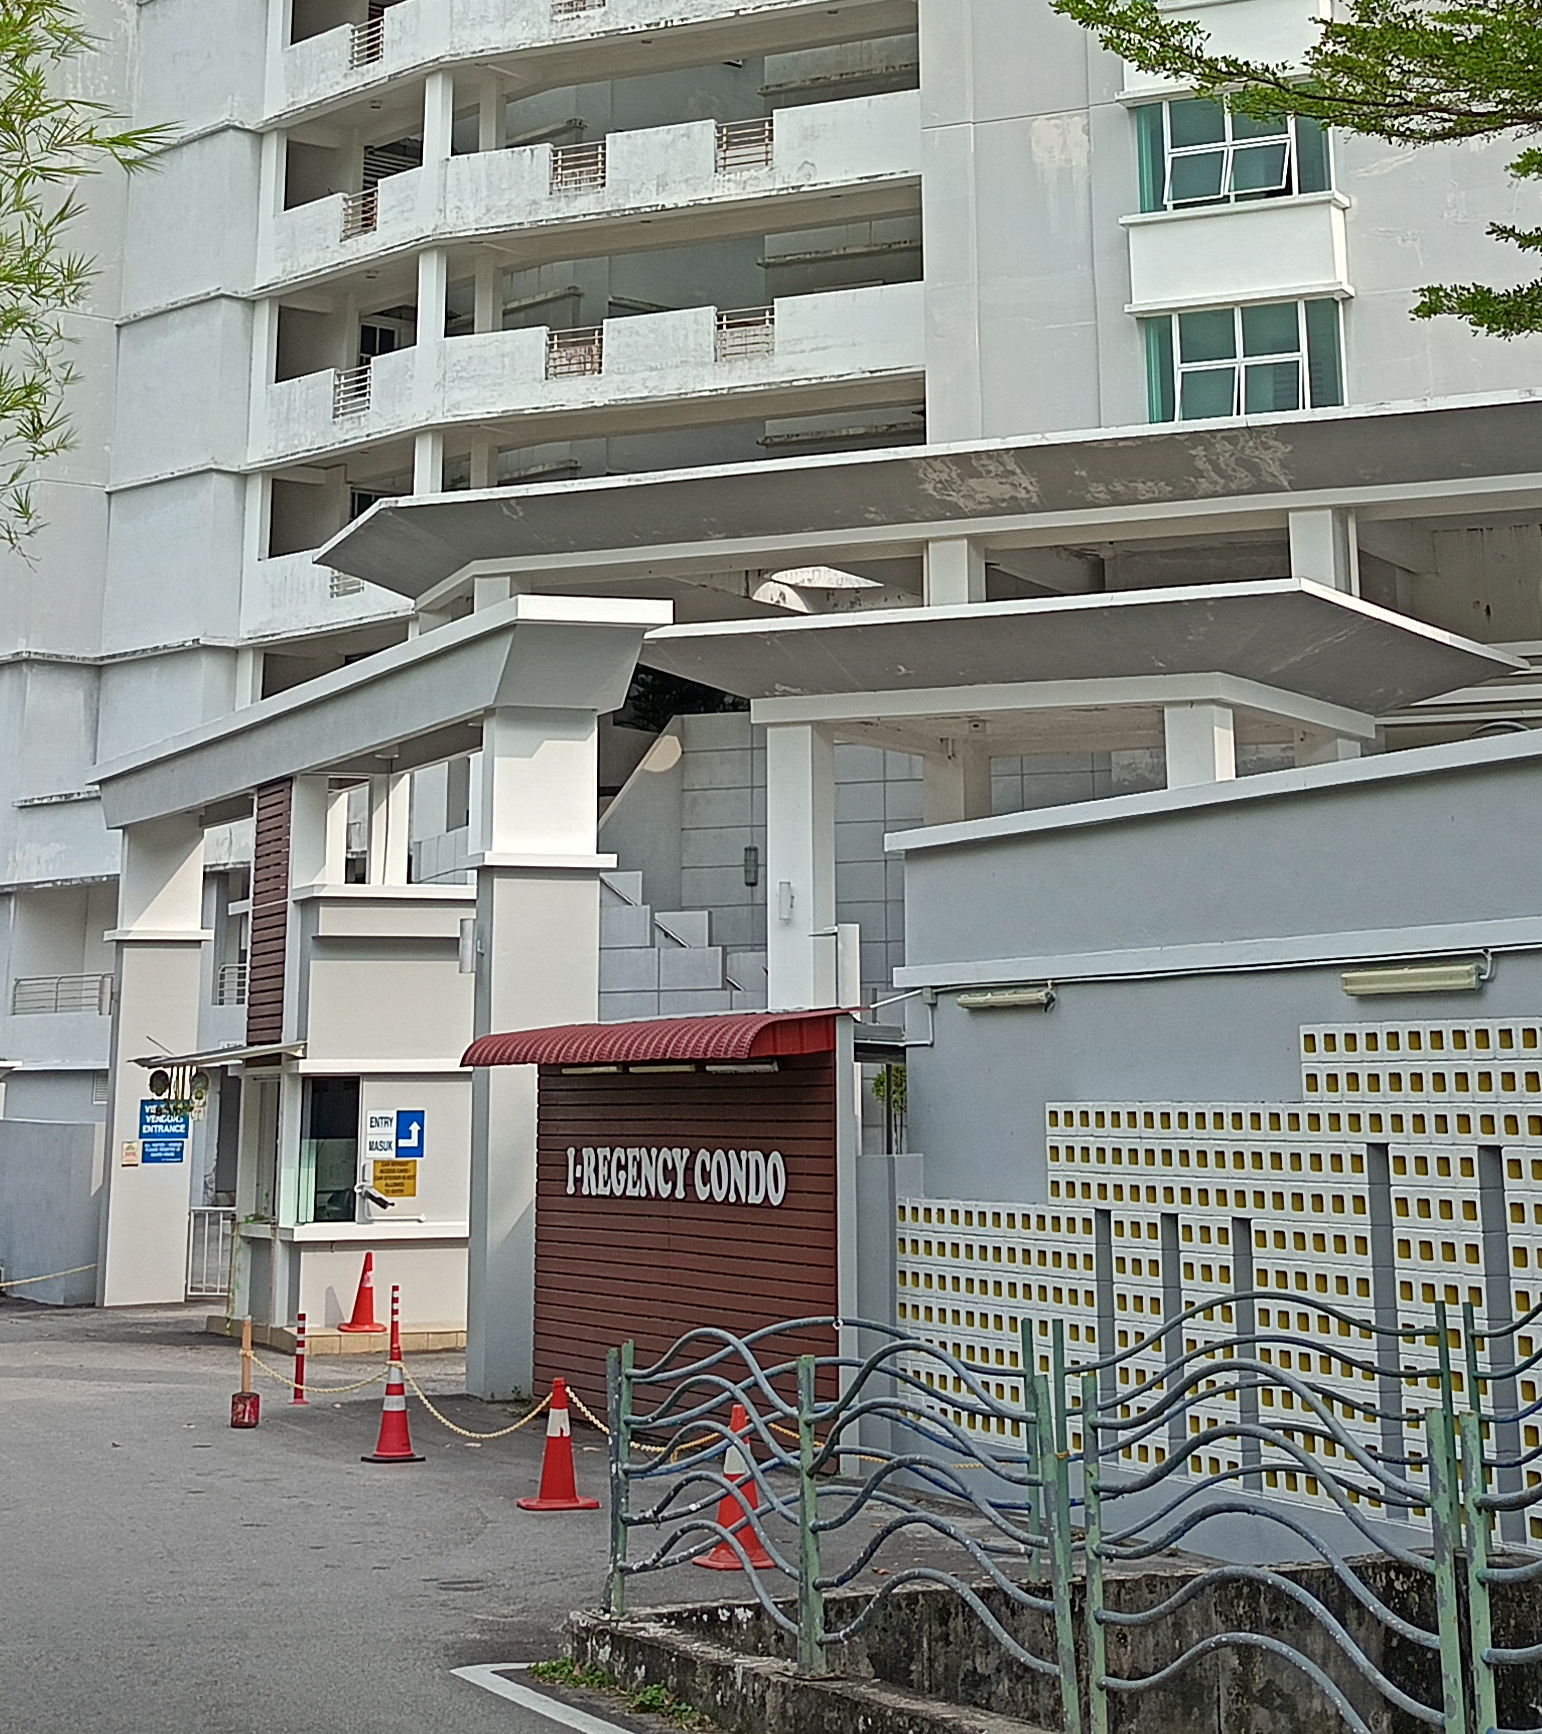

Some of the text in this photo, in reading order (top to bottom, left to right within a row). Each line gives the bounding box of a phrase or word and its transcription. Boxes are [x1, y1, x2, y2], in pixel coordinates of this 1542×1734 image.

[370, 1116, 394, 1128] ENTRY
[142, 1124, 186, 1134] ENTRANCE
[368, 1140, 393, 1151] MASUK
[566, 1146, 786, 1206] I-REGENCY CONDO
